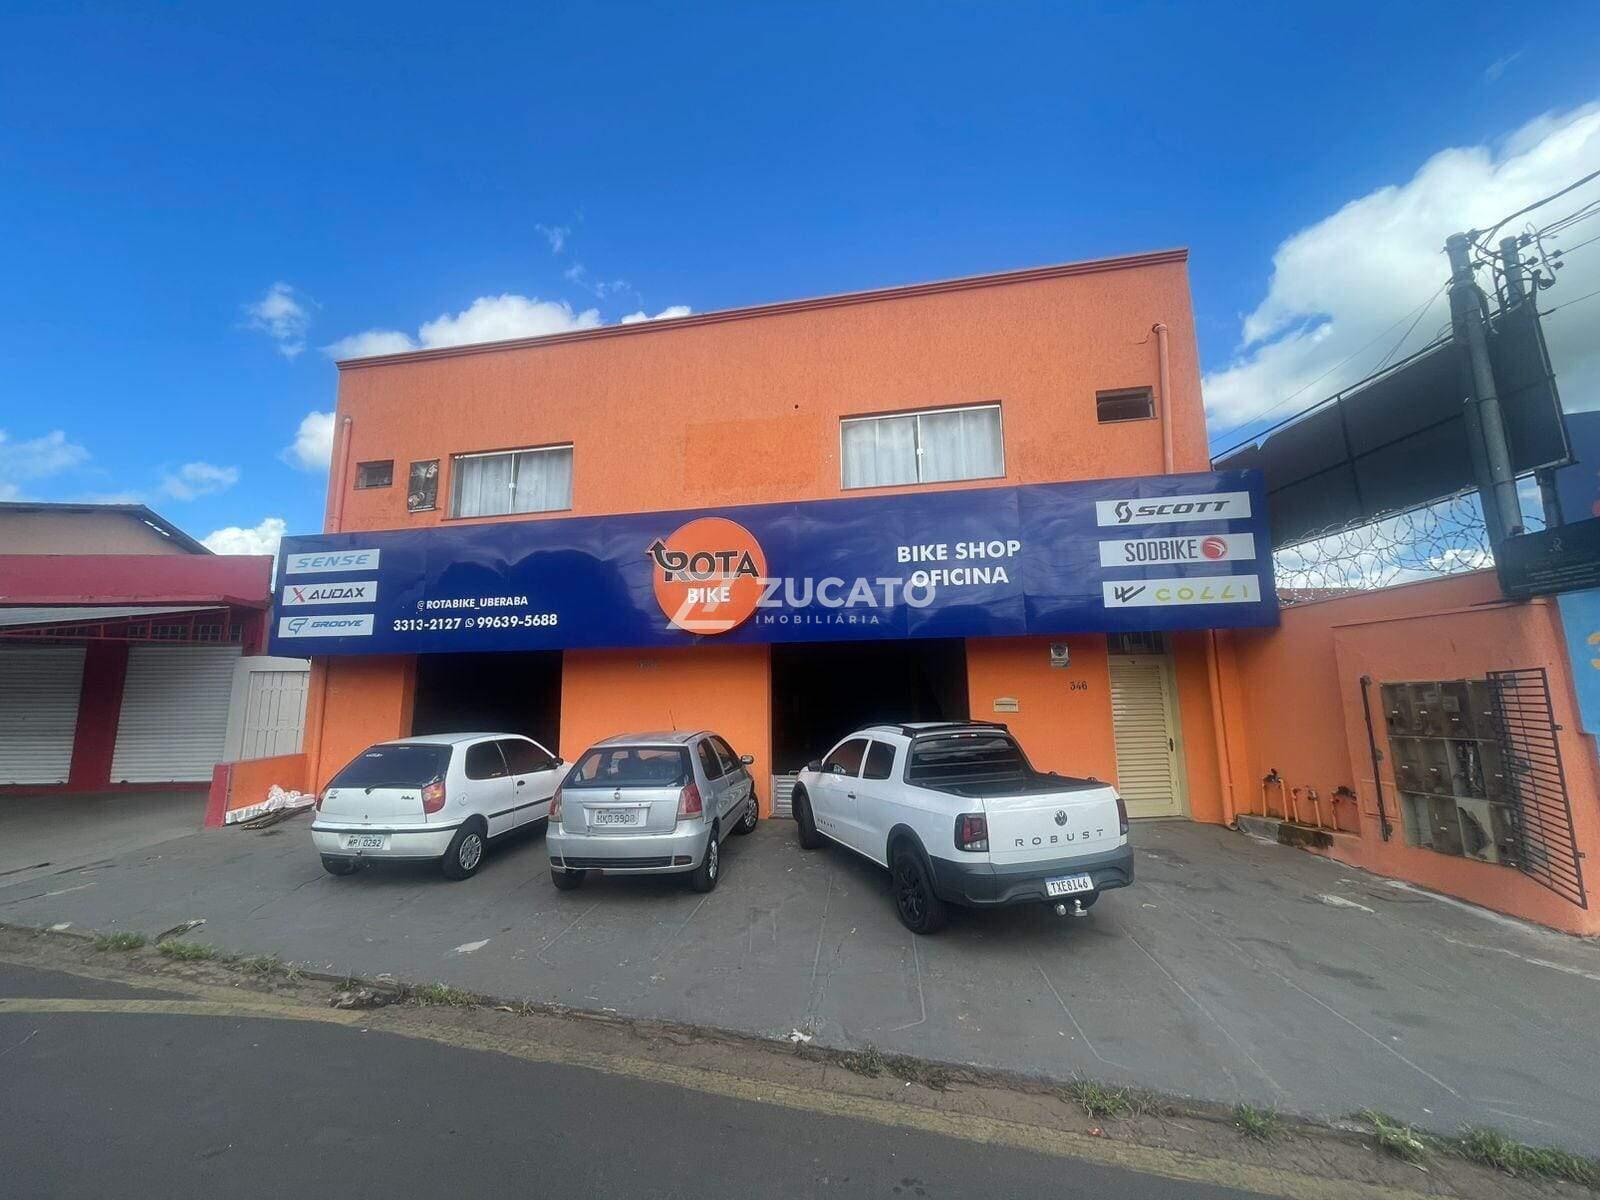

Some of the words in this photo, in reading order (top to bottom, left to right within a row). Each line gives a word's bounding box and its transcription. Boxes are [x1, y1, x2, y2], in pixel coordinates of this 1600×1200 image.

[1135, 500, 1231, 517] SCOTT
[897, 543, 948, 562] BIKE
[954, 540, 1021, 560] SHOP
[1124, 538, 1199, 562] SODBIKE
[295, 554, 370, 569] SENSE
[656, 546, 760, 582] ROTA
[911, 566, 1010, 588] OFICINA
[308, 587, 366, 600] AUDAX
[687, 587, 731, 604] BIKE
[1155, 584, 1249, 601] COLLI
[311, 619, 364, 628] GROOVE
[393, 617, 462, 631] 3313-2127
[477, 613, 558, 629] 99639-5688
[1015, 828, 1104, 847] ROBUST
